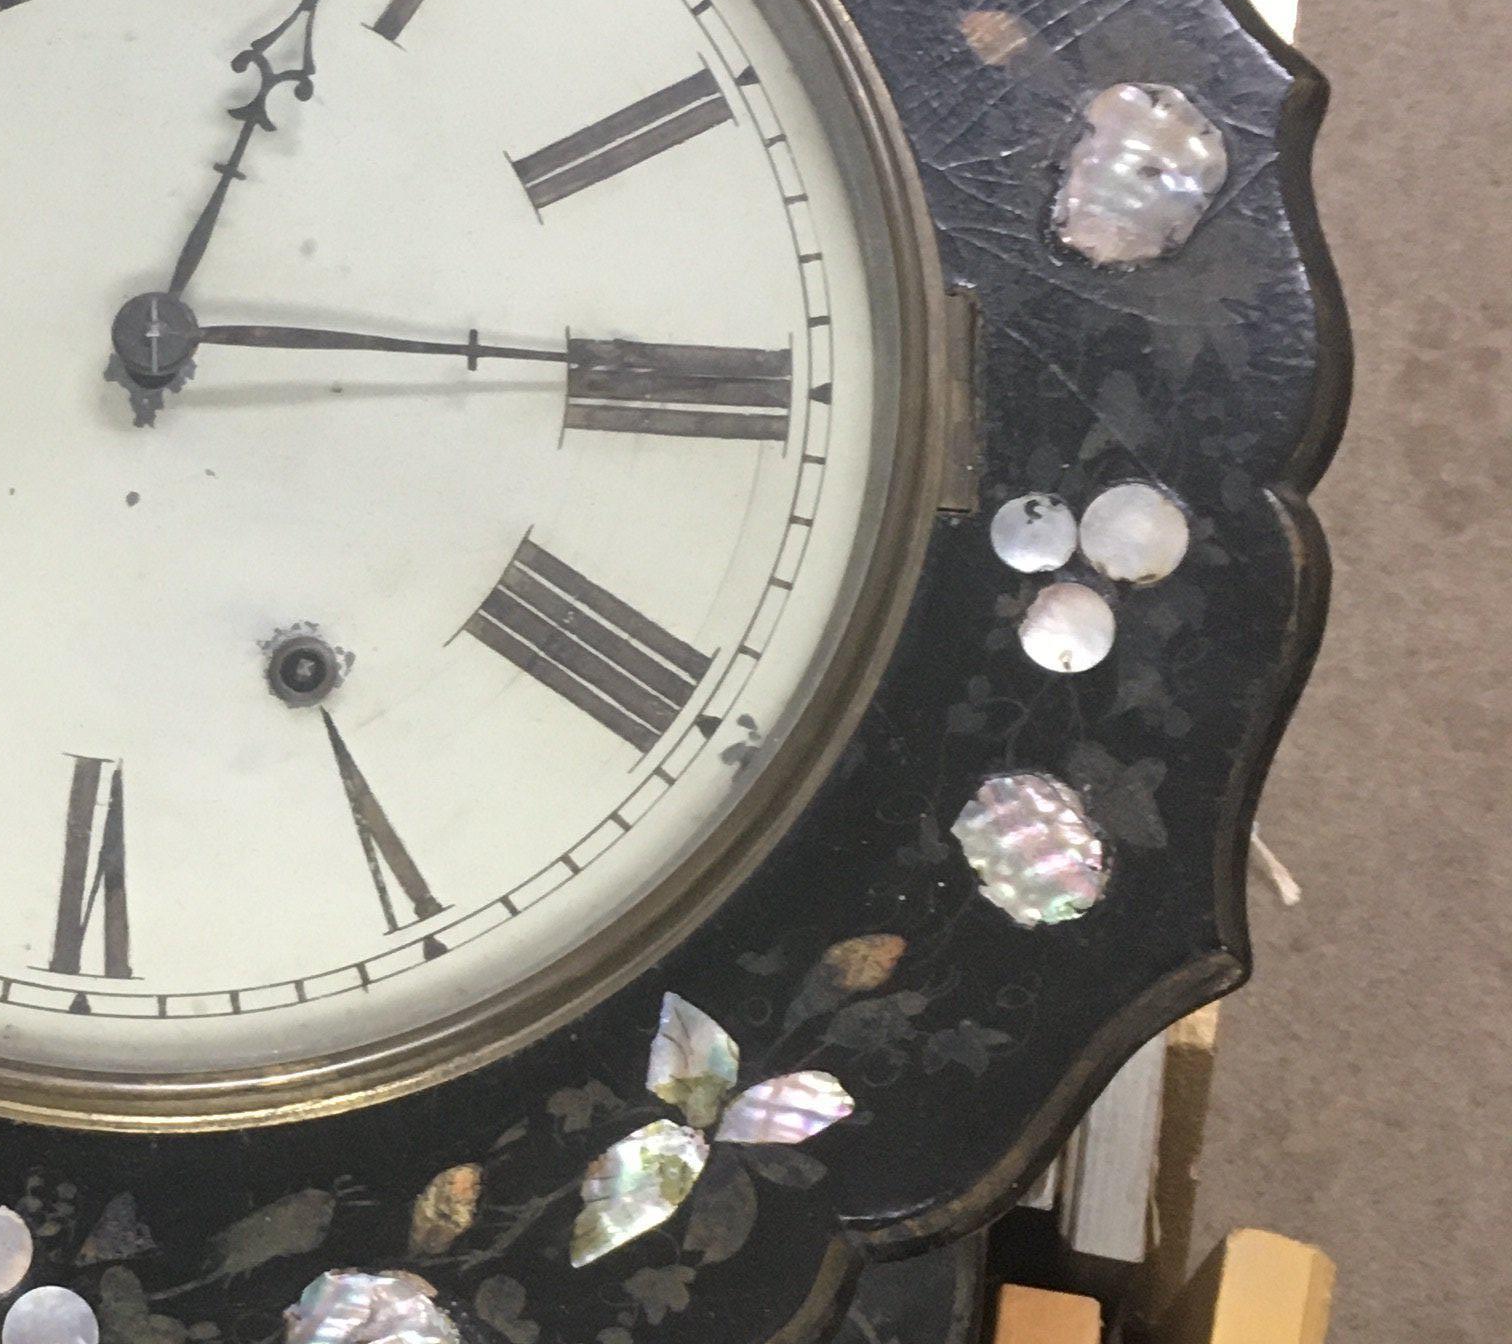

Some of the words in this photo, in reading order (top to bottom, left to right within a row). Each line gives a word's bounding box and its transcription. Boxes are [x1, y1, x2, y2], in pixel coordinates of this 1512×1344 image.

[504, 53, 738, 224] II
[560, 326, 793, 456] III
[445, 526, 721, 774] IIII
[28, 751, 146, 981] VI
[319, 706, 454, 934] V
